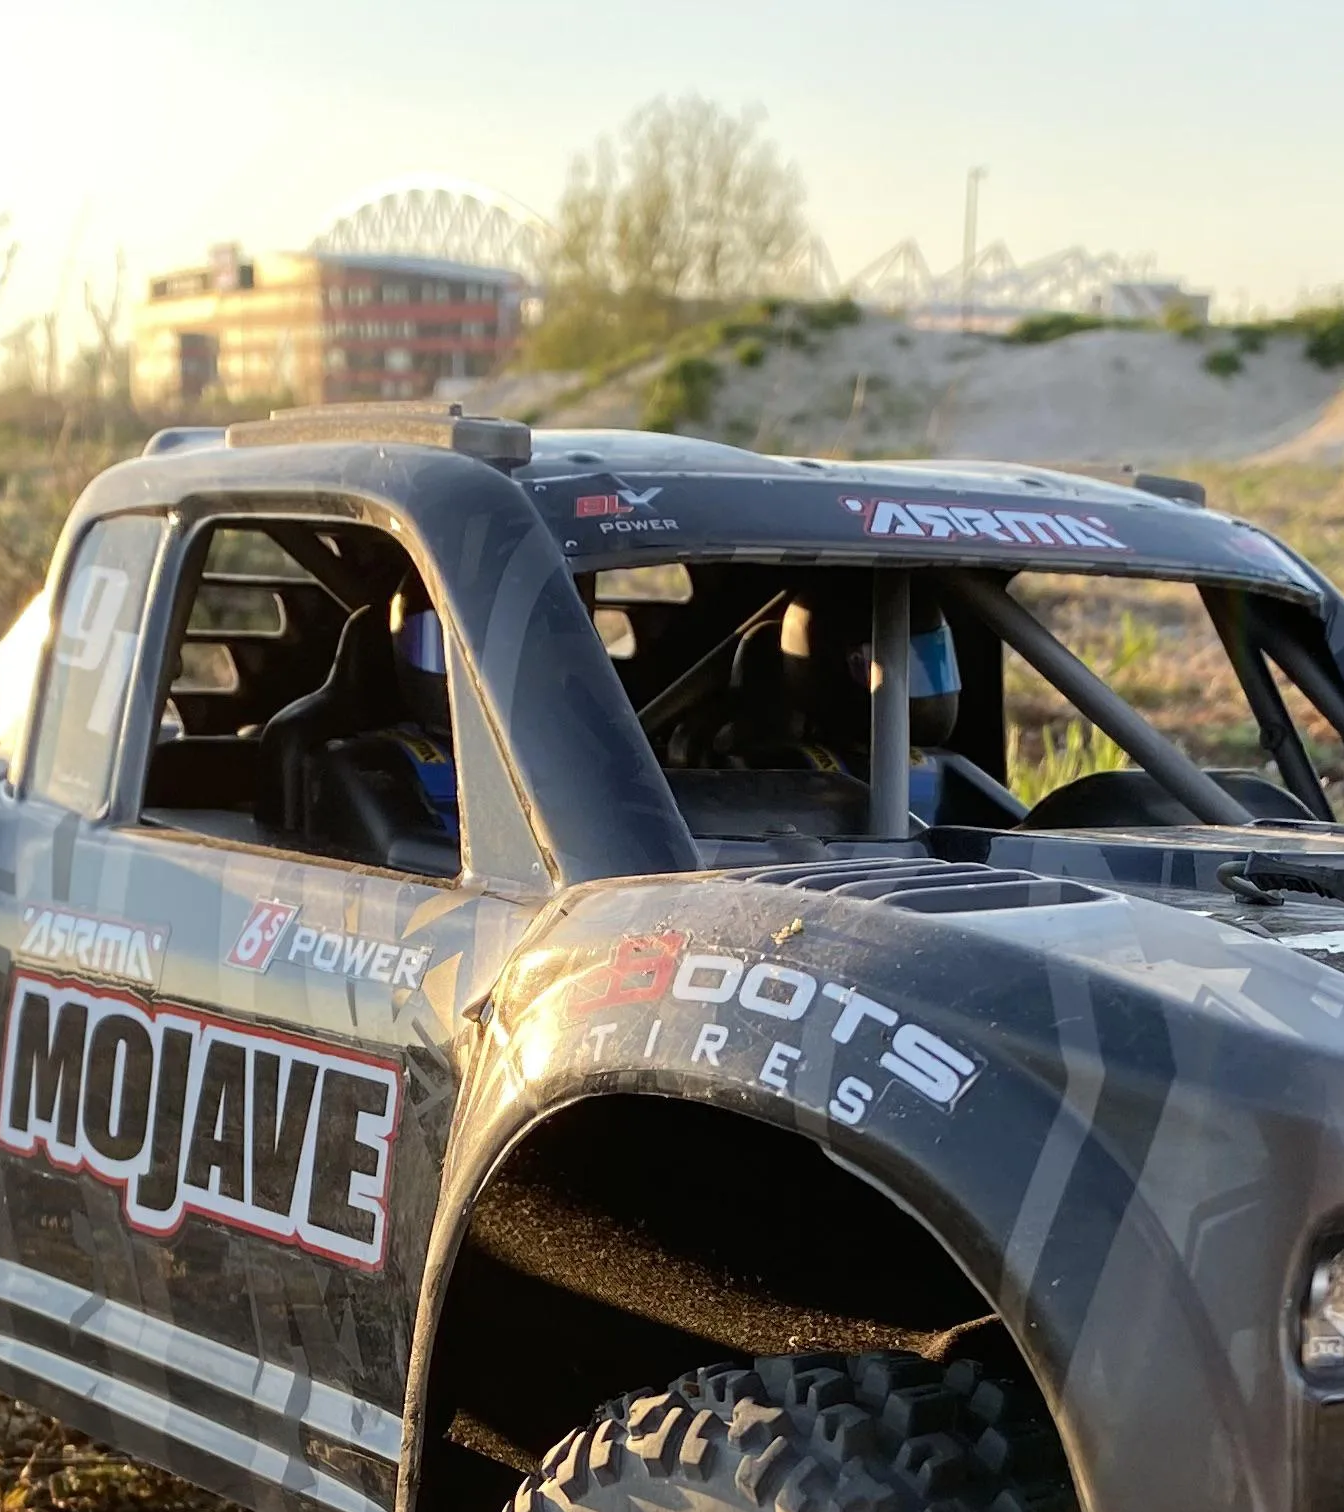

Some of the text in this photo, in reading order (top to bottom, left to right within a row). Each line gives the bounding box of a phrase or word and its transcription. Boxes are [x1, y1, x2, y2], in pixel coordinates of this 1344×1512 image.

[576, 486, 664, 518] BLX
[599, 519, 679, 534] POWER
[845, 499, 1129, 549] ARRMA
[19, 907, 161, 982] ARRMA
[288, 926, 431, 989] POWER
[589, 1019, 873, 1125] TIRES
[4, 985, 397, 1254] MOJAVE
